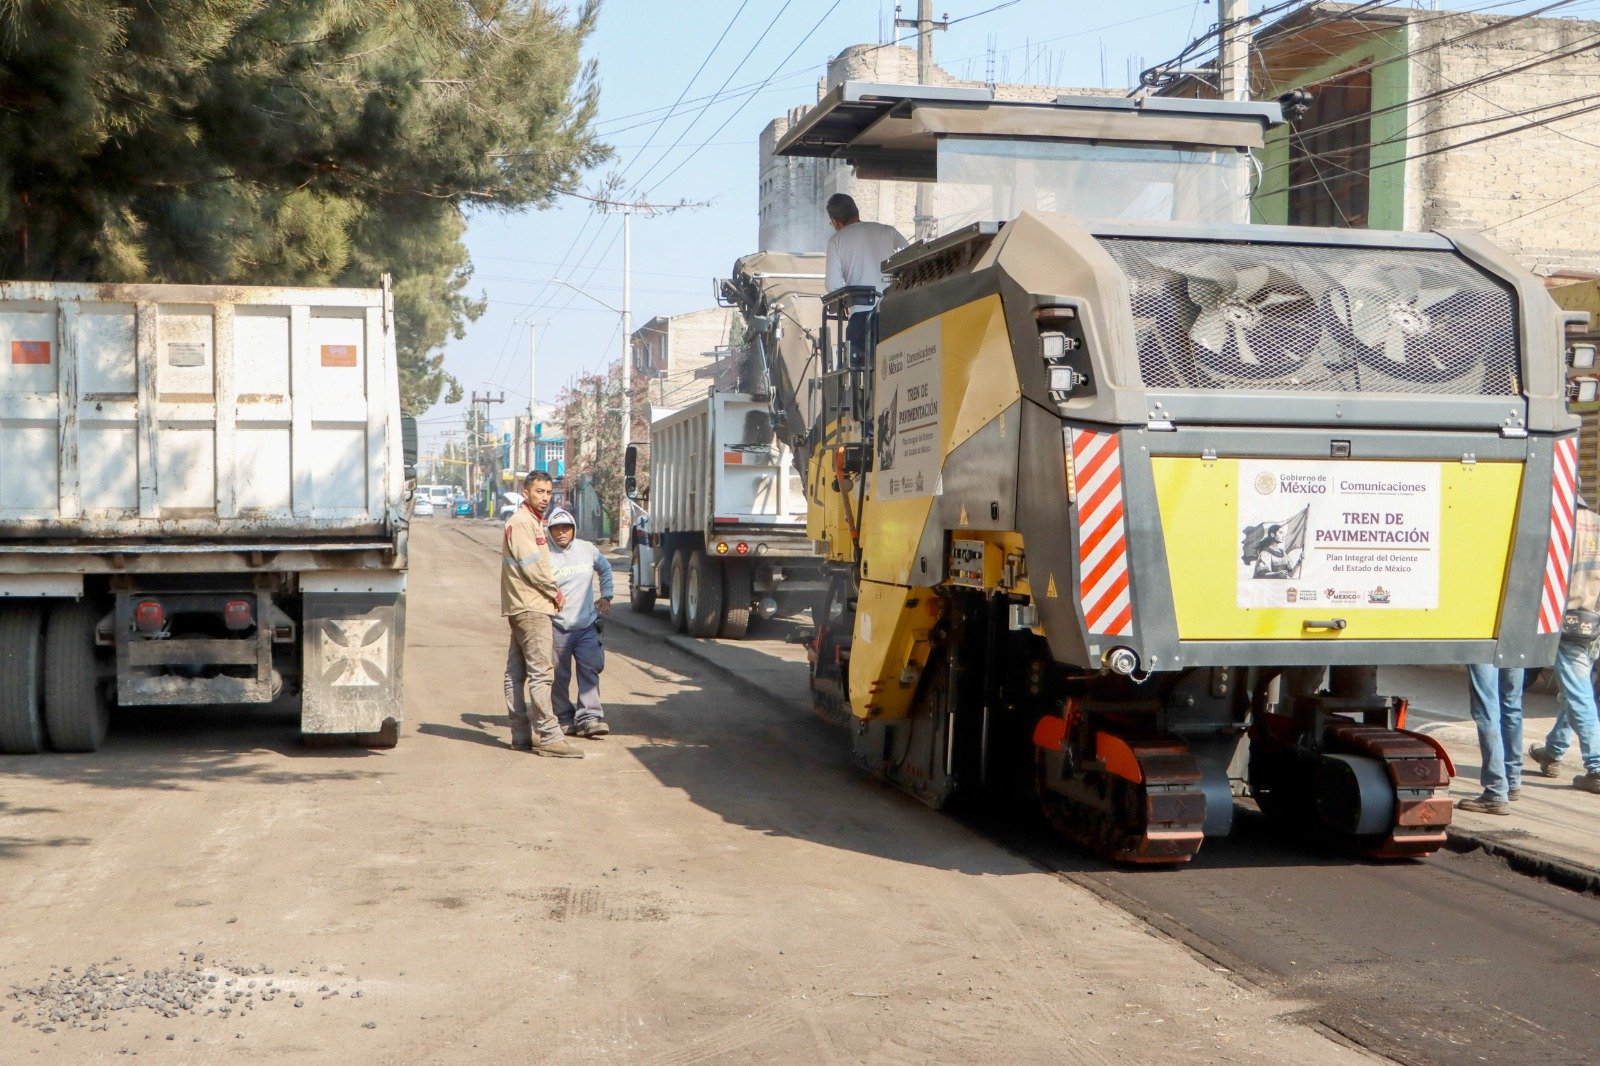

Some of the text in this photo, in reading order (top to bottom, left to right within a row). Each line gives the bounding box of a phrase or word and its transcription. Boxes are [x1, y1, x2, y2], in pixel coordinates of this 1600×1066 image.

[906, 344, 936, 364] Comunicaciones
[888, 360, 903, 374] México
[907, 383, 928, 402] TREN DE
[899, 398, 938, 424] PAVIMENTACIÓN
[1280, 482, 1326, 494] México
[1340, 480, 1426, 491] Comunicaciones
[1342, 512, 1404, 525] TREN DE
[1315, 527, 1429, 542] PAVIMENTACIÓN
[1345, 554, 1374, 563] Integral
